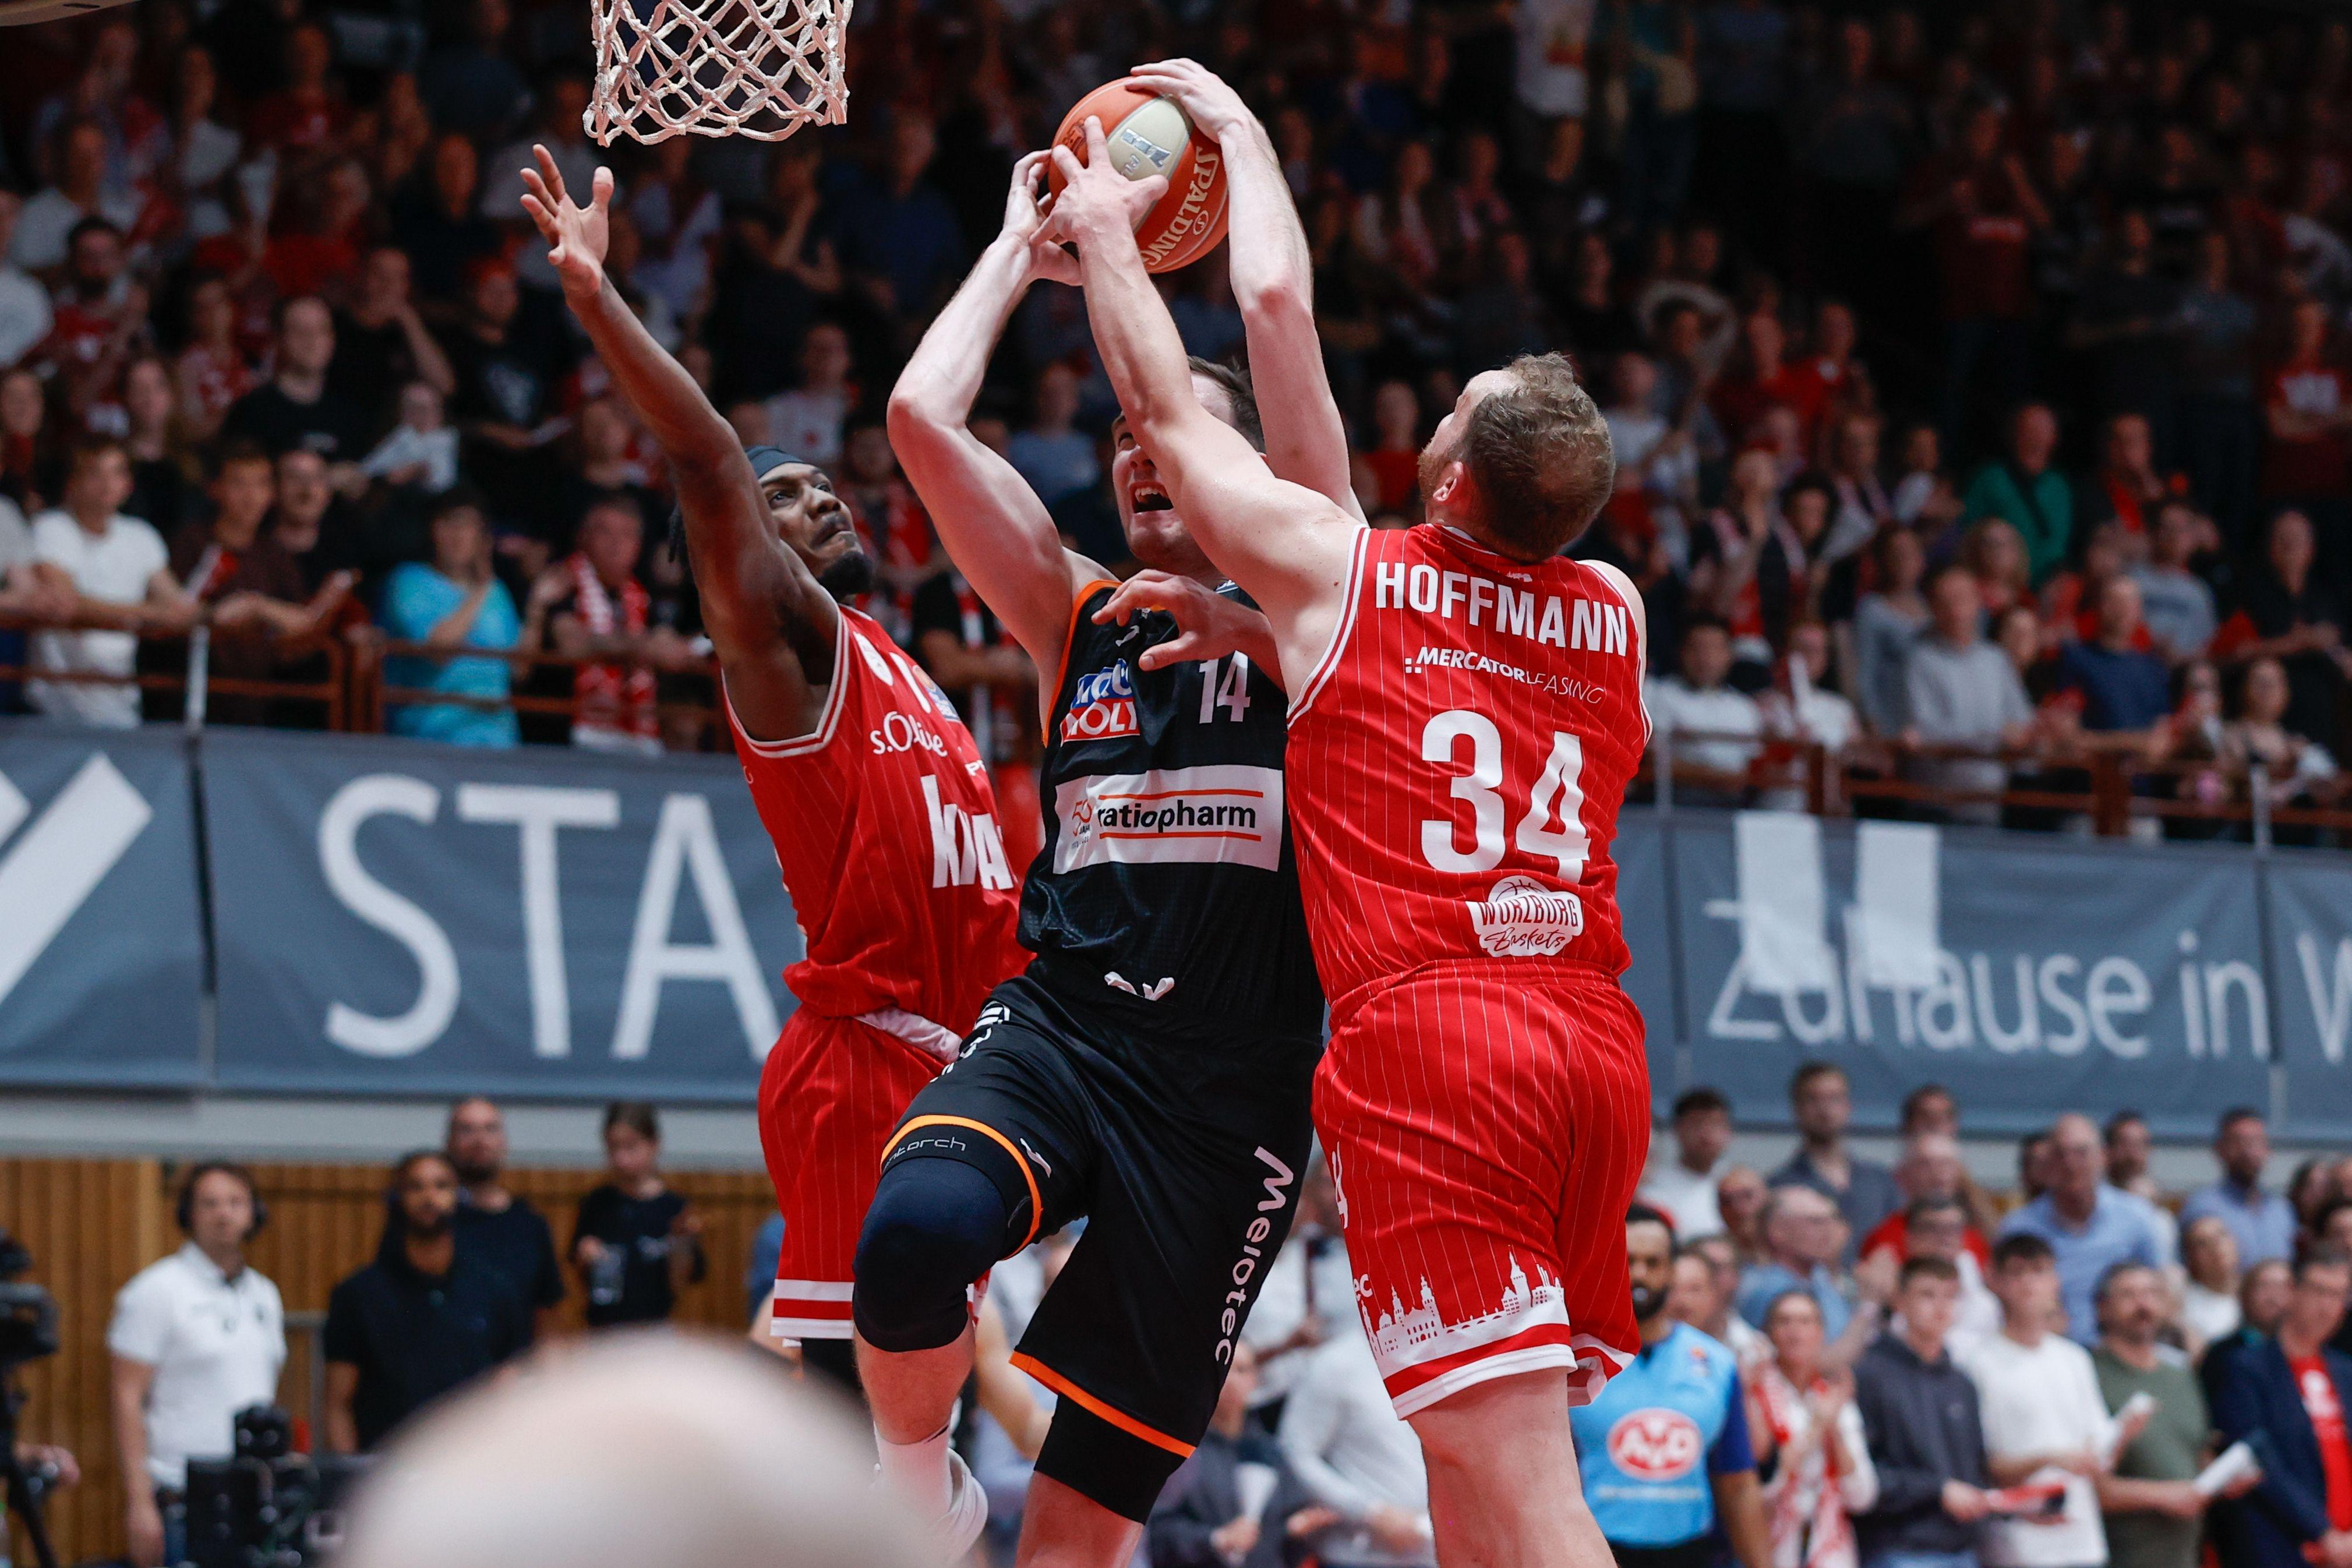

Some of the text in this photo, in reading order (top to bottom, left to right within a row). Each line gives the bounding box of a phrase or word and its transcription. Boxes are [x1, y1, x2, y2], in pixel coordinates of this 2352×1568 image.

[1140, 146, 1220, 266] SPALDING
[1376, 561, 1628, 657] HOFFMANN
[1199, 649, 1251, 724] 14
[870, 711, 962, 758] s.Olive
[1097, 799, 1256, 834] ratiopharm
[1421, 709, 1592, 885] 34
[318, 773, 784, 1062] STA
[1484, 927, 1566, 952] Baskets
[2177, 930, 2270, 1060] in
[883, 1136, 966, 1172] ntorch
